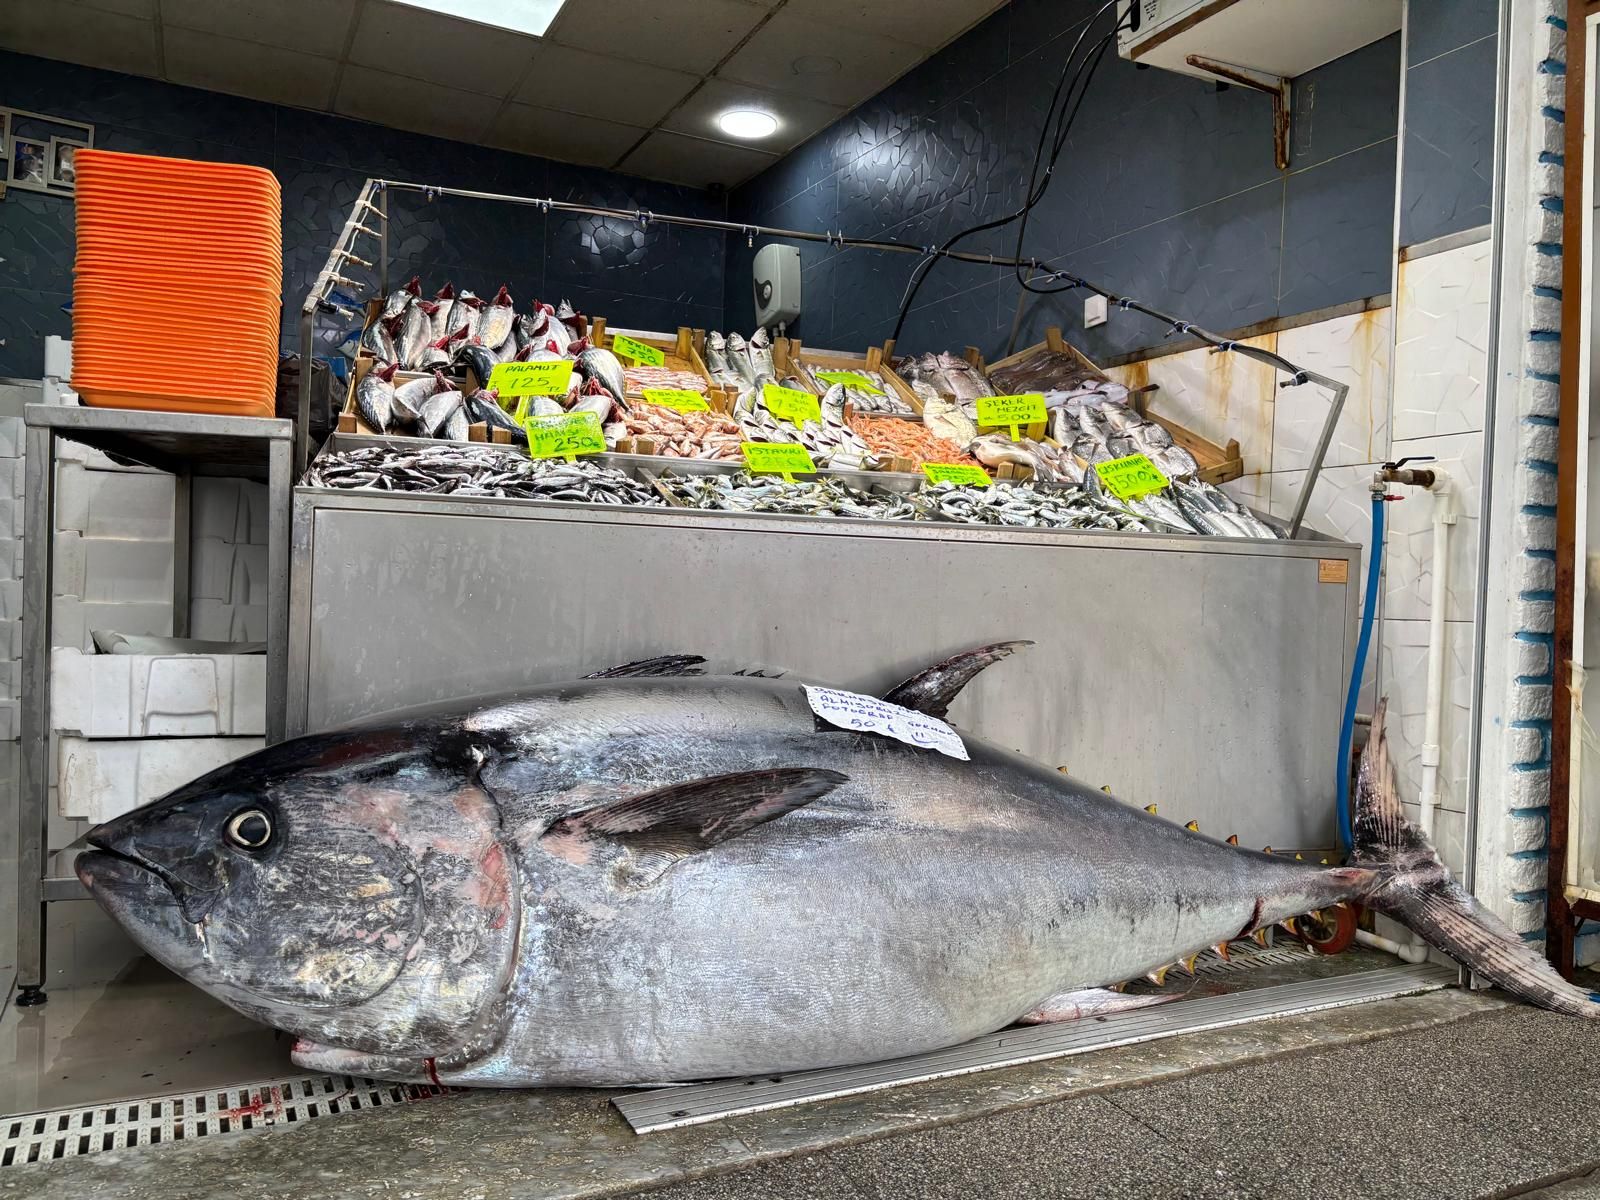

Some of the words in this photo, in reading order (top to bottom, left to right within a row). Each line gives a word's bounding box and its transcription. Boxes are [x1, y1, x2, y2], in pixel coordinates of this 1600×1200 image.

[505, 364, 560, 374] PALAMUT
[510, 377, 551, 389] 125
[998, 413, 1031, 422] 500
[554, 436, 594, 452] 250
[850, 718, 876, 728] 50
